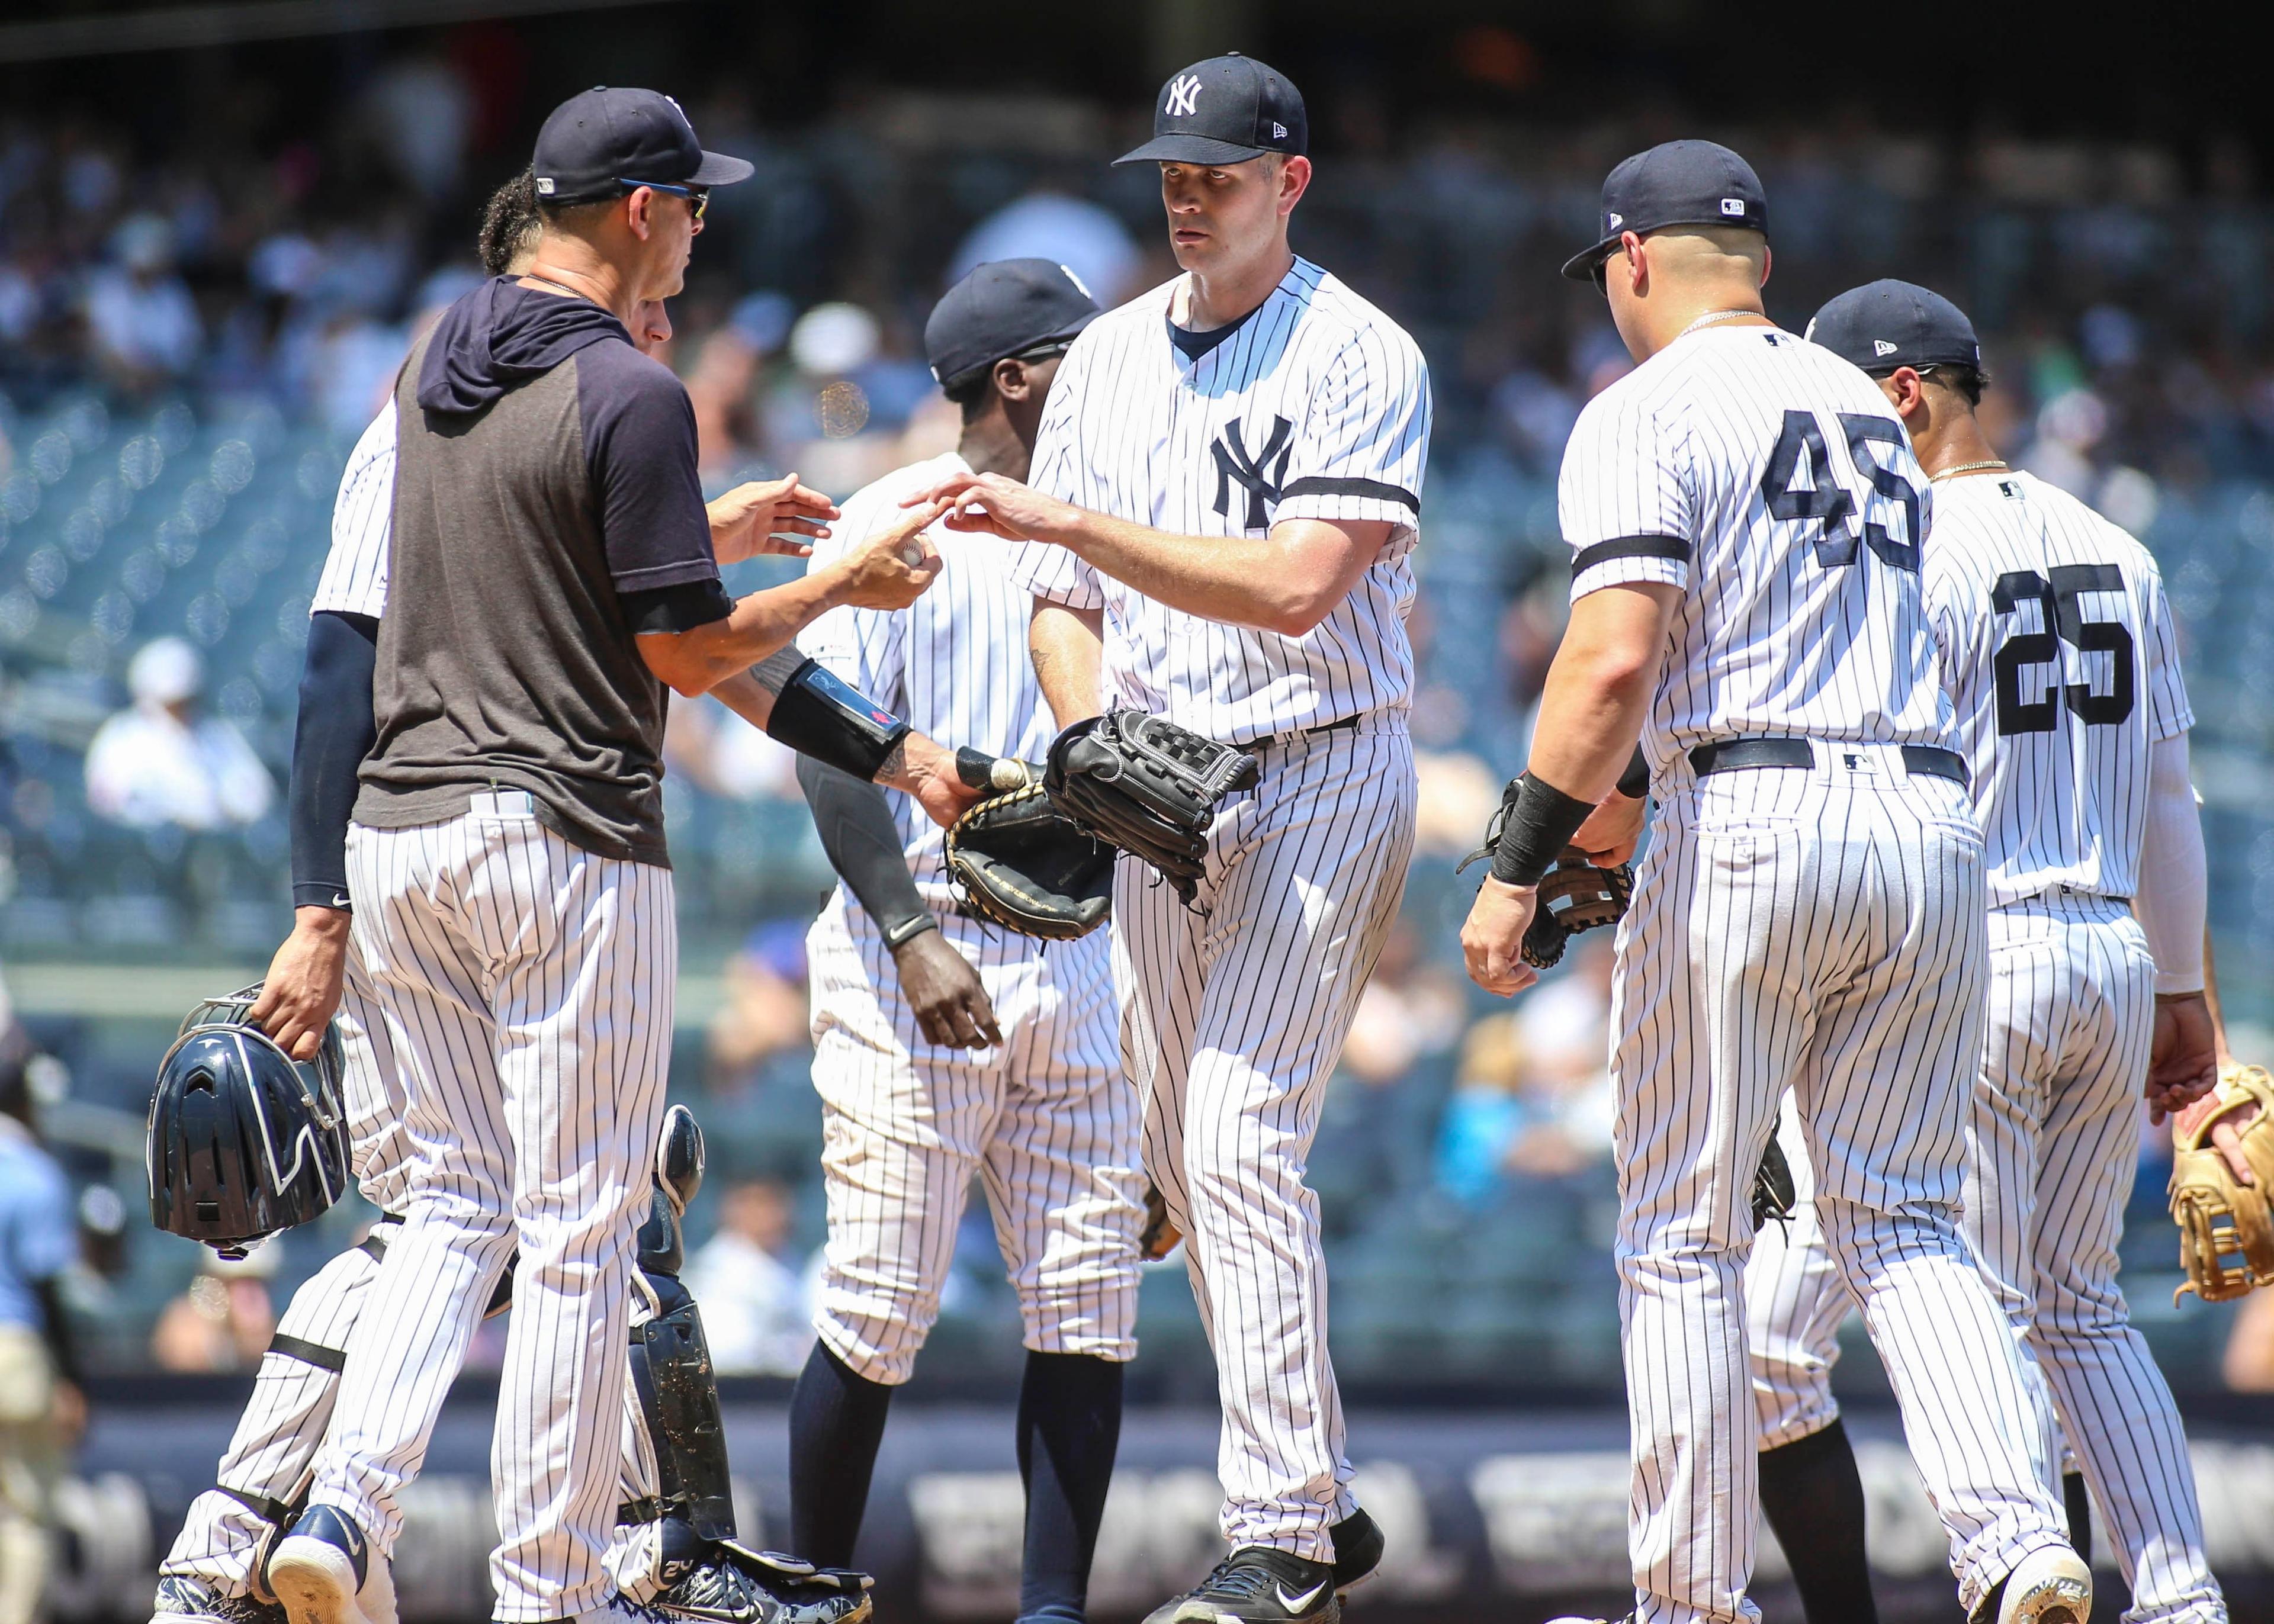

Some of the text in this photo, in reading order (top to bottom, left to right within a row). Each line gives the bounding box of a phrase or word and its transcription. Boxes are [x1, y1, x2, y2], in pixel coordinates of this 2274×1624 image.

[1165, 75, 1203, 116] NY
[1210, 413, 1295, 529] NY
[1761, 410, 1920, 575] 45
[1991, 564, 2134, 736] 25
